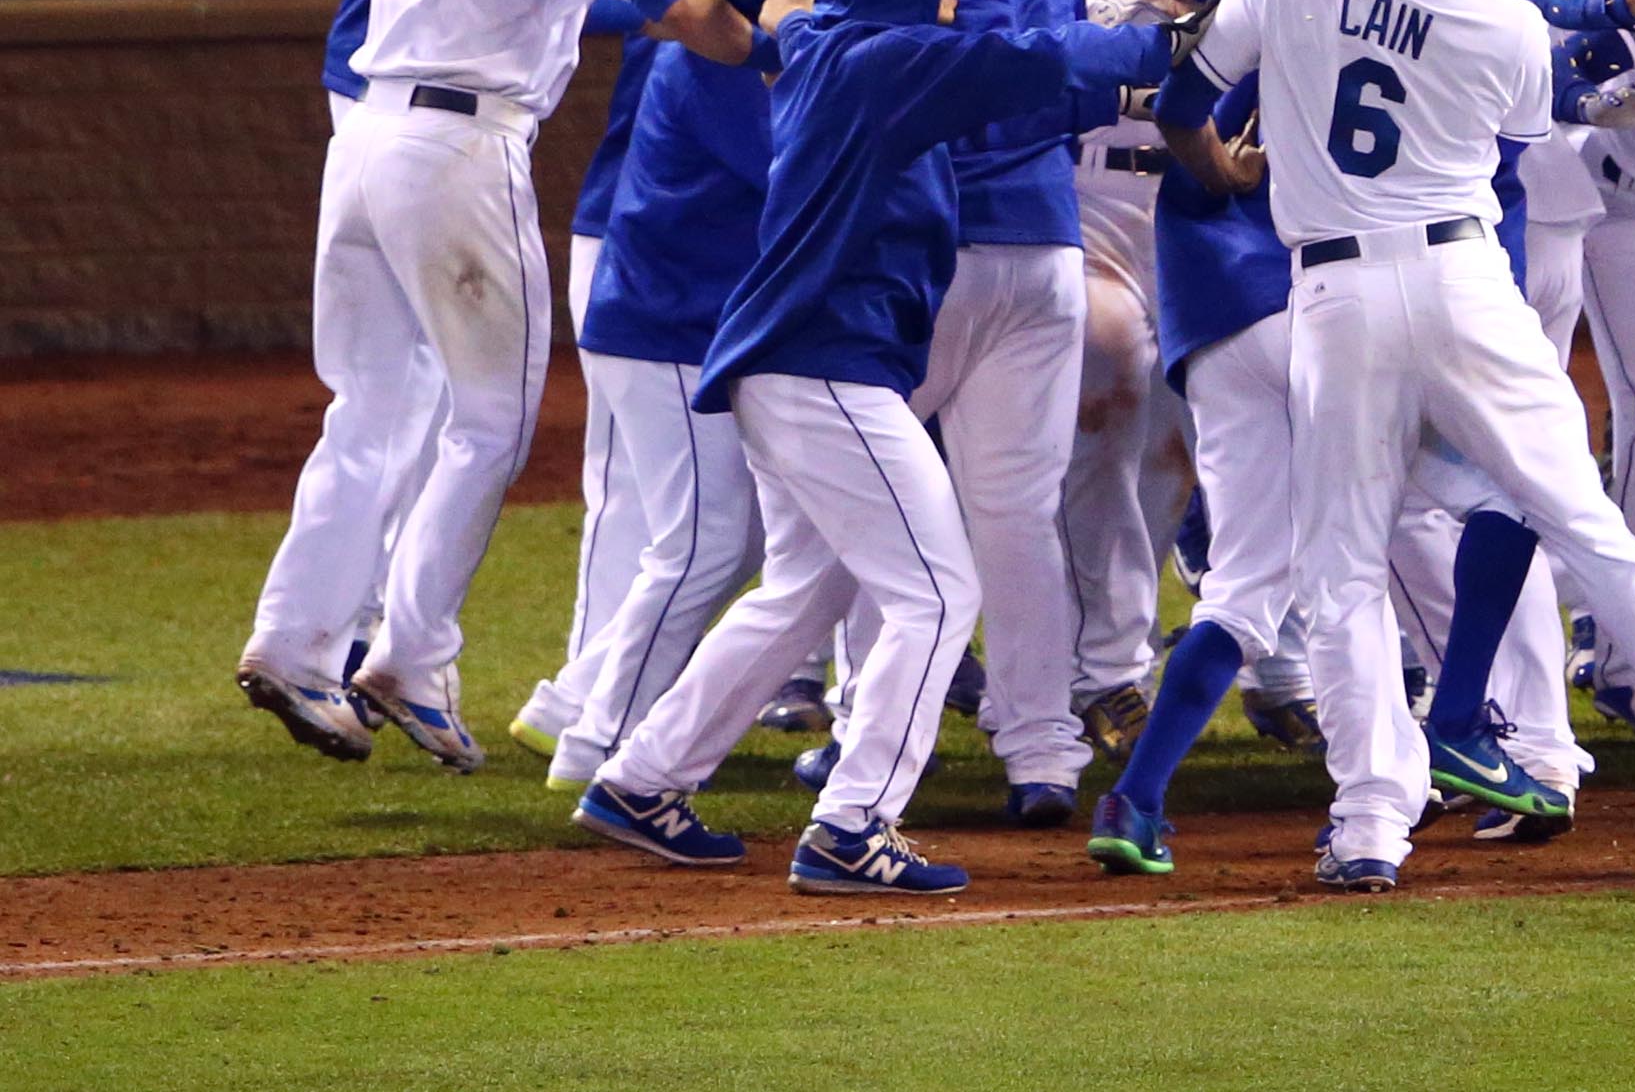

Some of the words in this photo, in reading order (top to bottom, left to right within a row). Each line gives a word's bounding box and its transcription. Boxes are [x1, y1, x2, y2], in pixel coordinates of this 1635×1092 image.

[1327, 56, 1407, 179] 6
[652, 809, 696, 840] N
[864, 854, 907, 885] N
